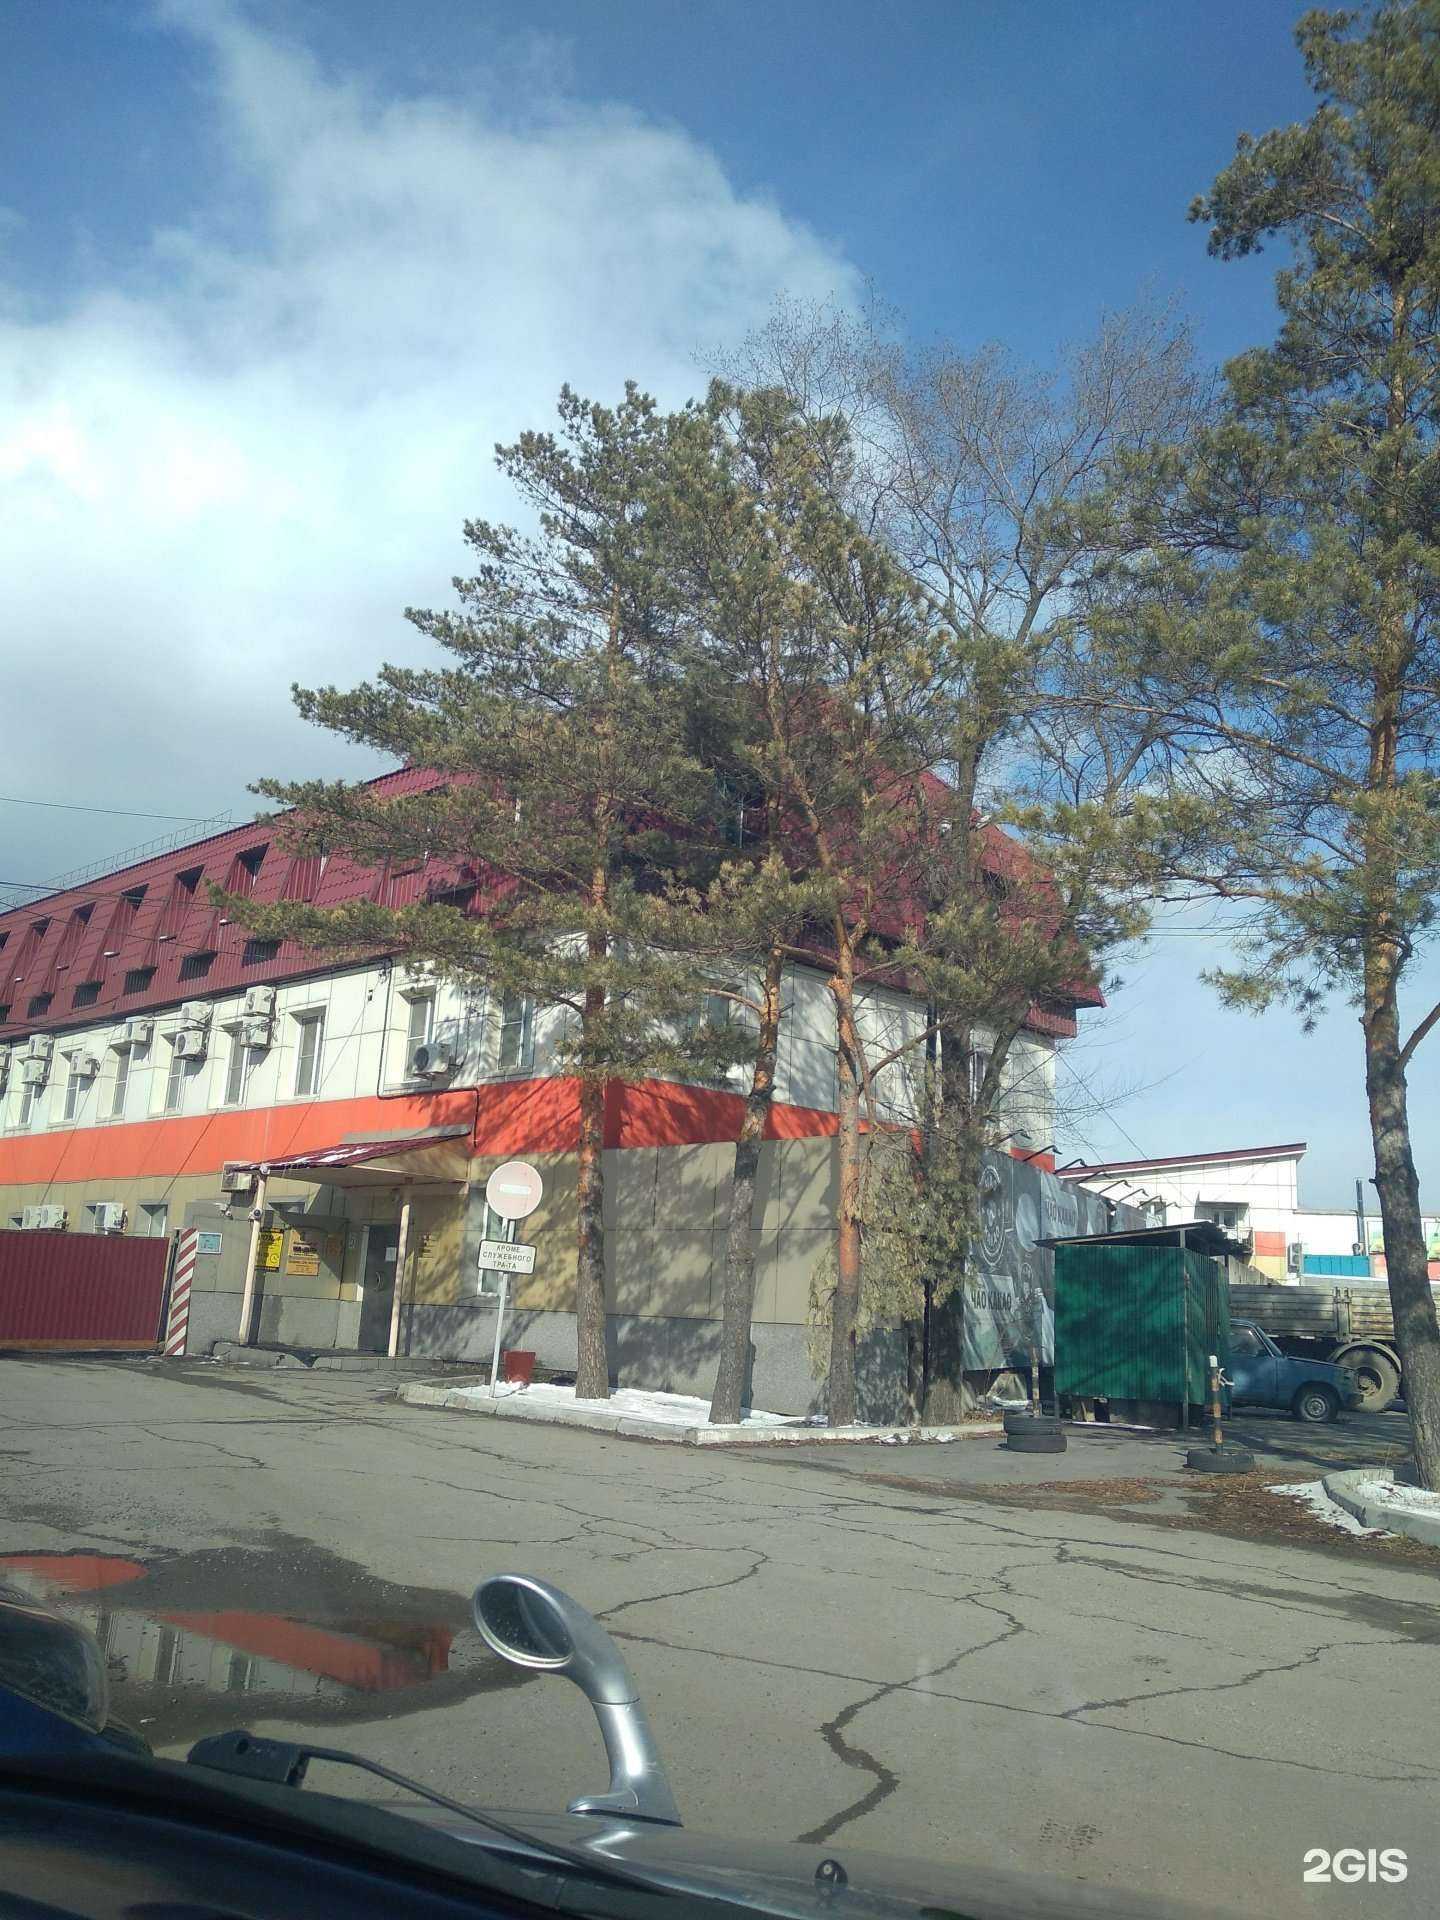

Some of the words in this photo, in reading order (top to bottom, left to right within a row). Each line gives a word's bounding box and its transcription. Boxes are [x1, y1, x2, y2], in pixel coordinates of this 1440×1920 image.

[497, 1245, 520, 1253] КРОМЕ
[483, 1251, 531, 1262] СЛУЖЕБНОГО
[971, 1290, 987, 1309] ЧАО
